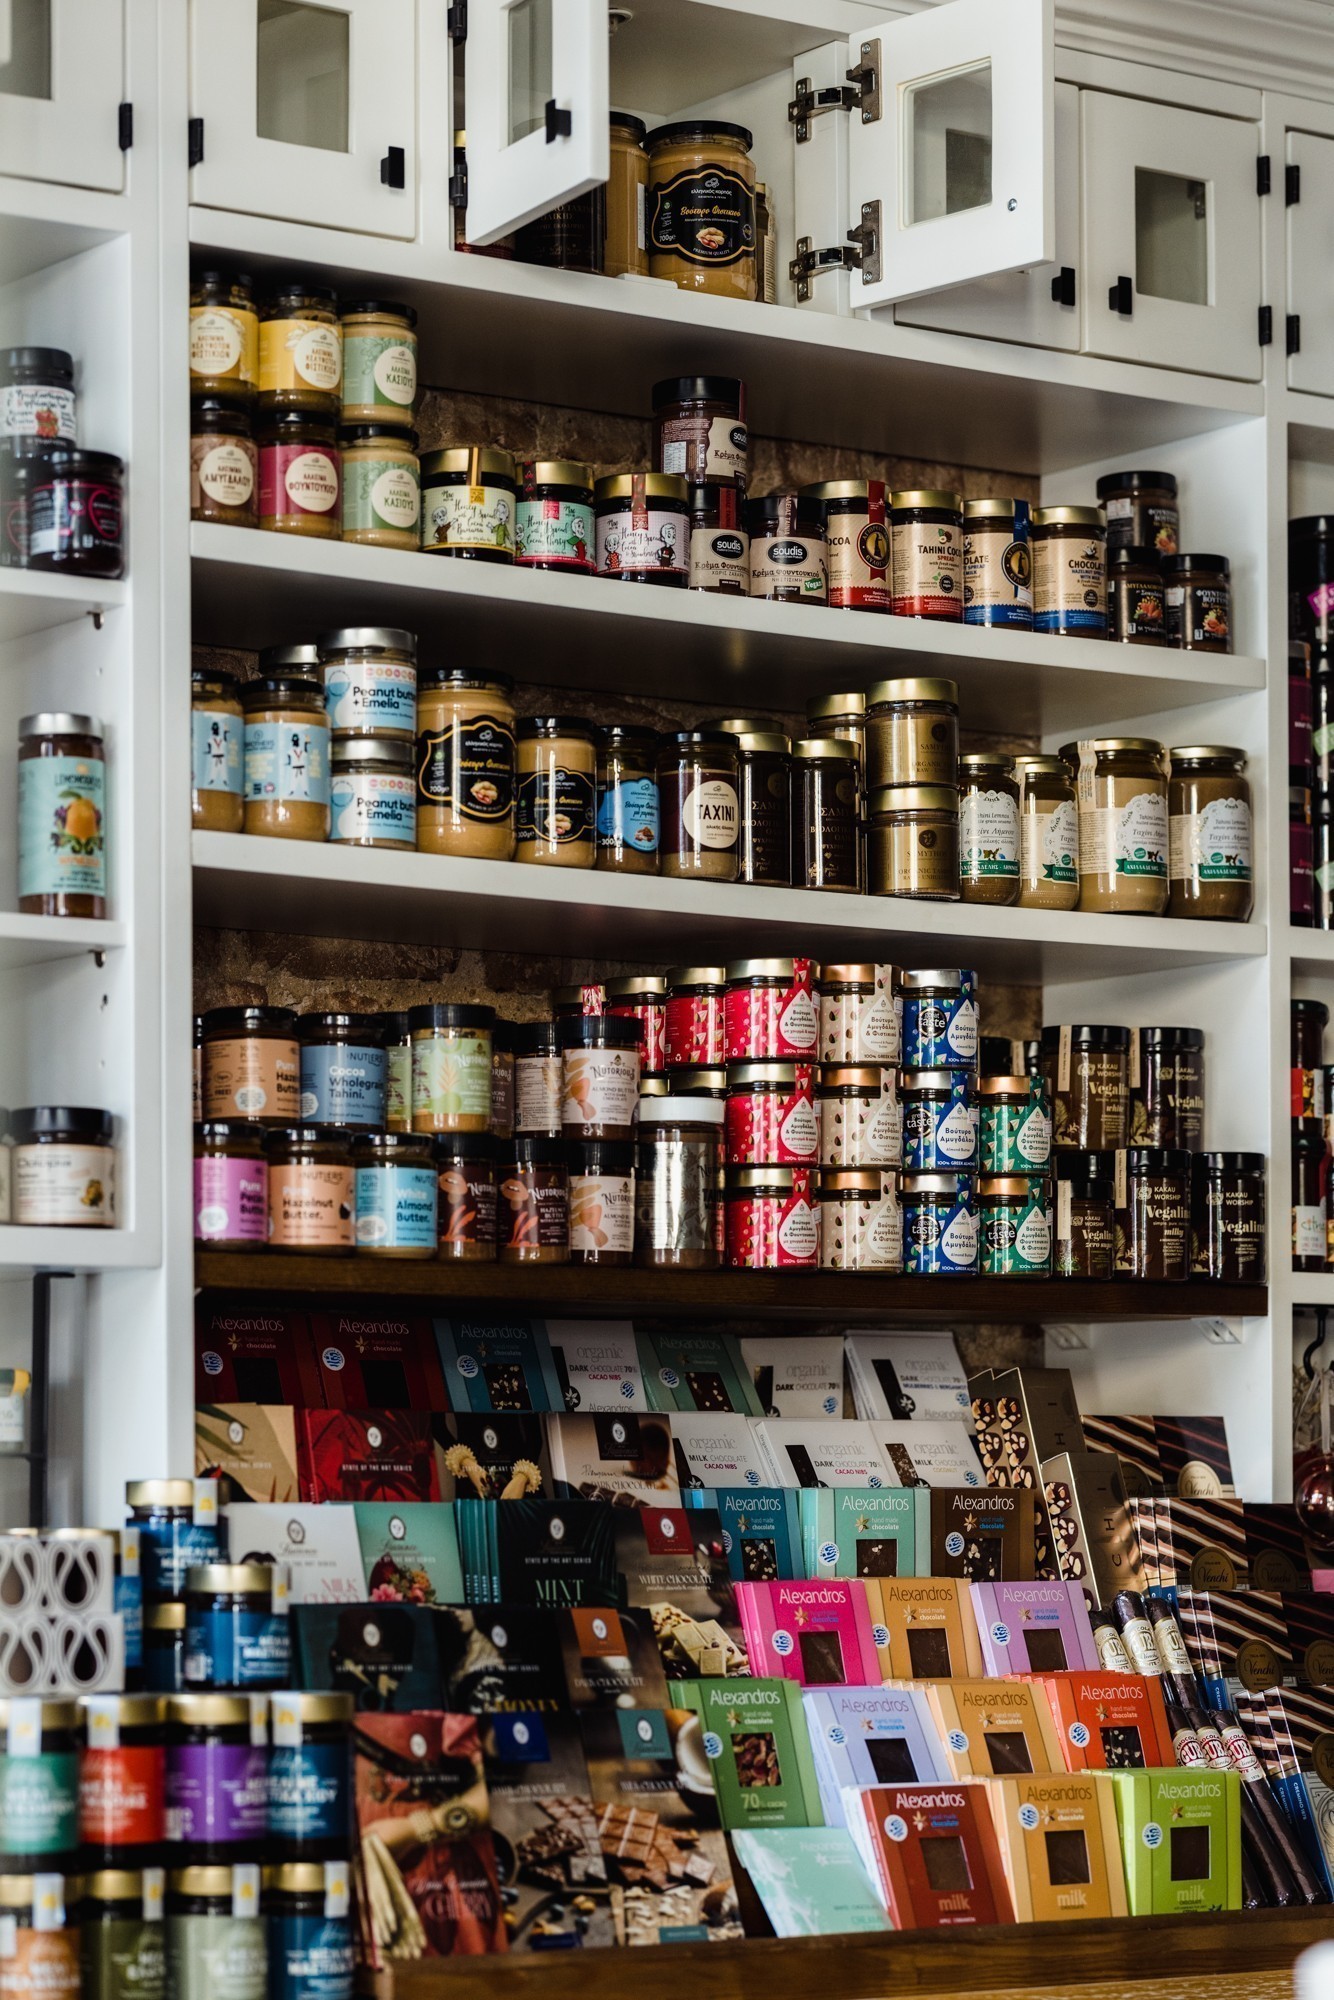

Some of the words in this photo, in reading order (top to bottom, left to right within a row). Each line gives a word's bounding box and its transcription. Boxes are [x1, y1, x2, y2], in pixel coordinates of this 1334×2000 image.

[717, 540, 741, 550] soudis
[829, 537, 850, 545] OCOA
[773, 546, 803, 556] soudis
[918, 545, 945, 554] TAHINI
[353, 686, 395, 698] Peanut
[362, 699, 399, 709] Emelia
[357, 798, 399, 809] Peanut
[366, 809, 402, 821] Emelia
[329, 1066, 366, 1077] Cocoa
[329, 1088, 365, 1100] Tahini.
[907, 1117, 933, 1128] taste
[396, 1188, 426, 1199] White
[283, 1198, 334, 1210] Hazelnut
[396, 1200, 432, 1212] Almond
[396, 1212, 430, 1223] Butter.
[912, 1225, 939, 1235] taste
[988, 1230, 1015, 1240] taste
[211, 1316, 284, 1332] Alexandros
[338, 1318, 409, 1335] Alexandros
[460, 1324, 528, 1339] Alexandros
[576, 1343, 624, 1362] organic
[786, 1361, 830, 1377] organic
[776, 1383, 794, 1391] DARK
[690, 1434, 737, 1452] organic
[819, 1441, 865, 1458] organic
[914, 1440, 959, 1456] organic
[710, 1455, 748, 1463] CHOCOLATE
[725, 1495, 781, 1511] Alexandros
[842, 1495, 909, 1511] Alexandros
[952, 1494, 1014, 1510] Alexandros
[1198, 1566, 1228, 1584] Venchi
[535, 1579, 584, 1600] MINT
[779, 1588, 846, 1605] Alexandros
[889, 1586, 953, 1602] Alexandros
[1003, 1587, 1065, 1602] Alexandros
[1244, 1658, 1275, 1676] Venchi
[710, 1688, 781, 1706] Alexandros
[963, 1691, 1028, 1707] Alexandros
[1080, 1684, 1144, 1701] Alexandros
[841, 1699, 909, 1713] Alexandros
[1027, 1786, 1092, 1802] Alexandros
[1157, 1781, 1222, 1799] Alexandros
[896, 1792, 965, 1809] Alexandros
[1056, 1890, 1087, 1906] milk
[1176, 1885, 1205, 1902] milk
[939, 1894, 971, 1911] milk
